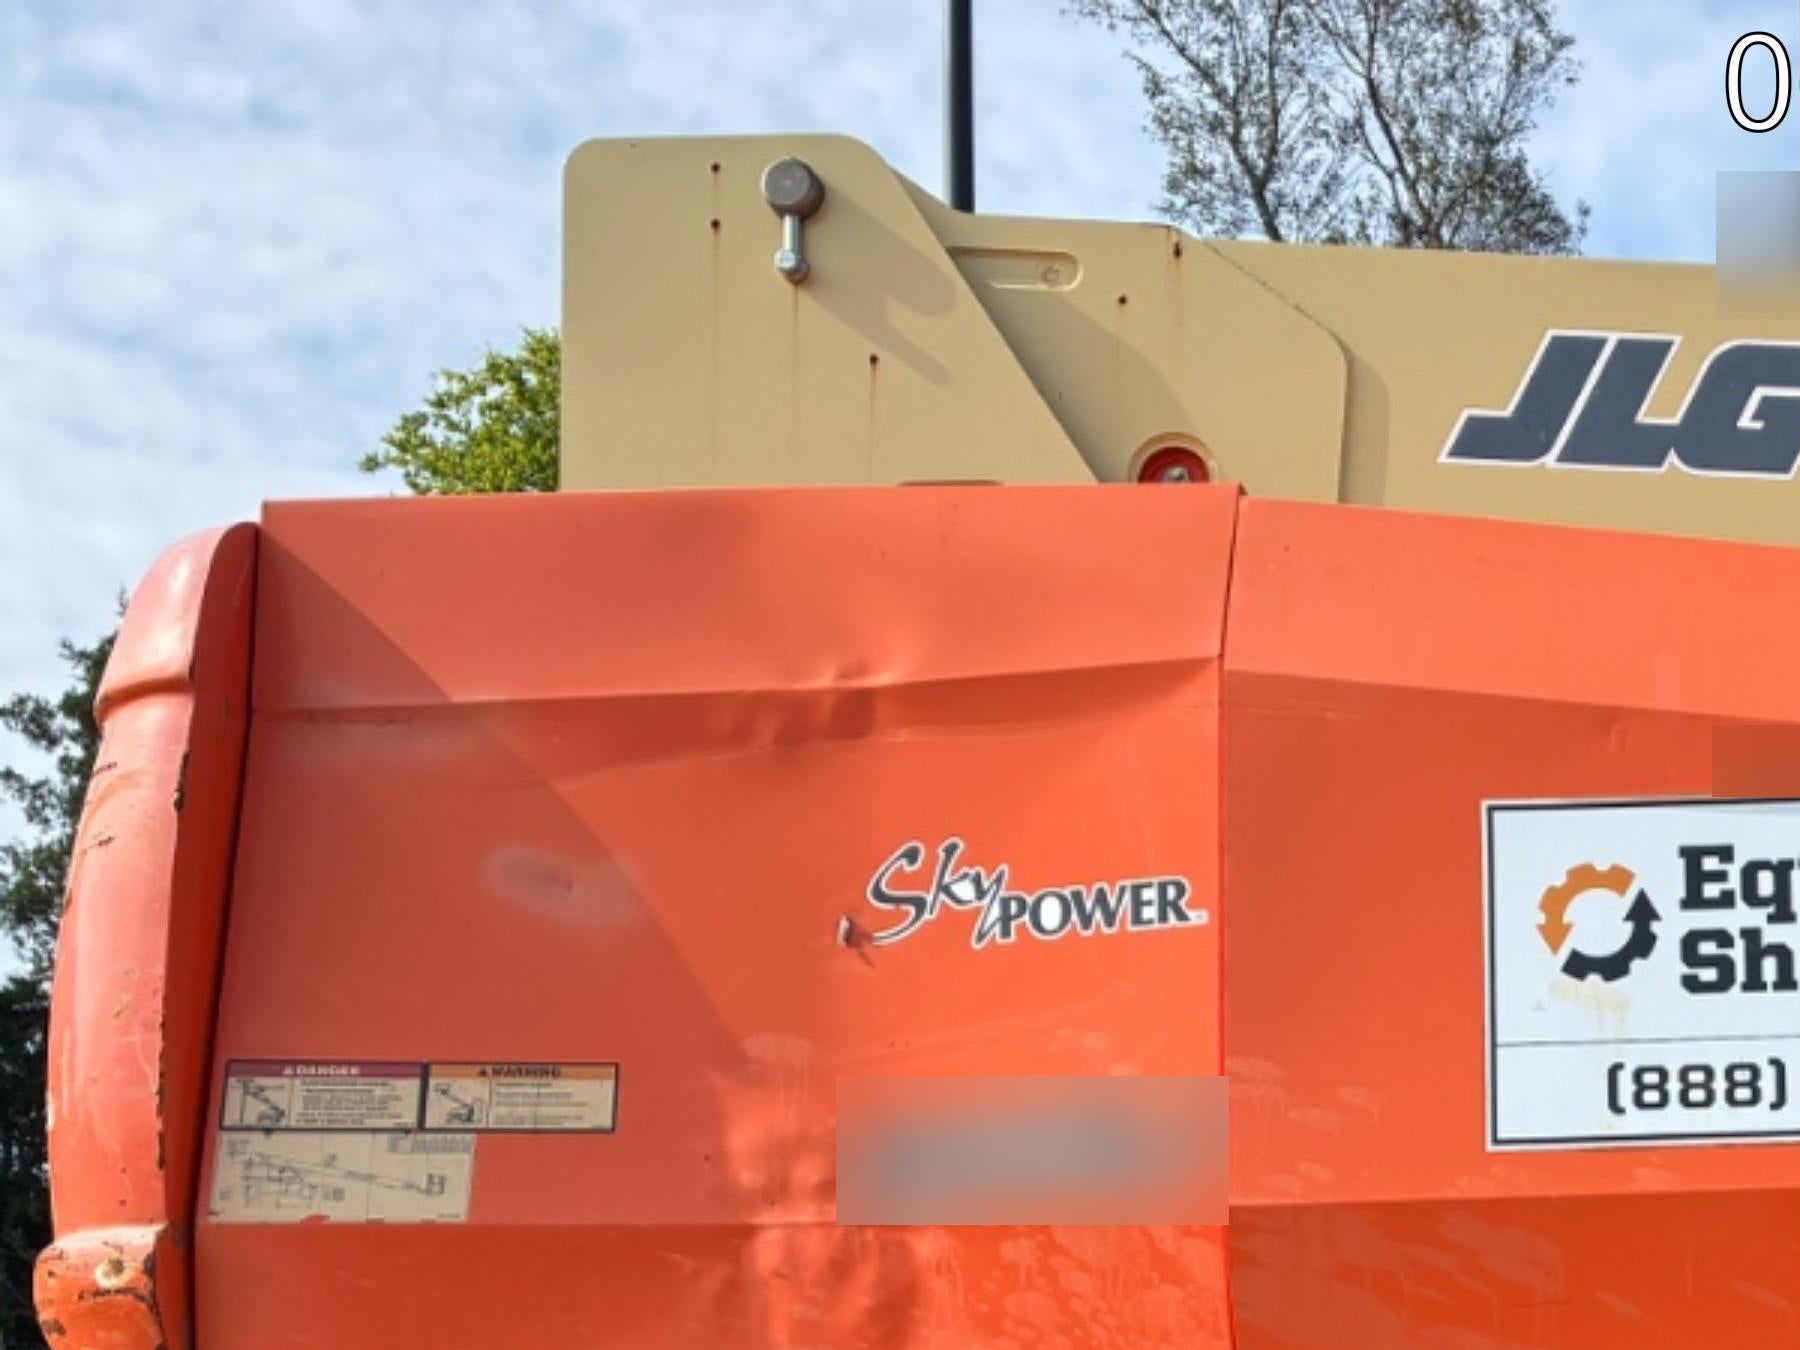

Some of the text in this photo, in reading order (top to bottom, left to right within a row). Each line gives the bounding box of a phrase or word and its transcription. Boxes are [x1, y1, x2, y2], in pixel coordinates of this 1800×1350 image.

[295, 1064, 361, 1076] DANGER
[491, 1066, 562, 1078] WARNING
[1607, 1057, 1788, 1114] (888)
